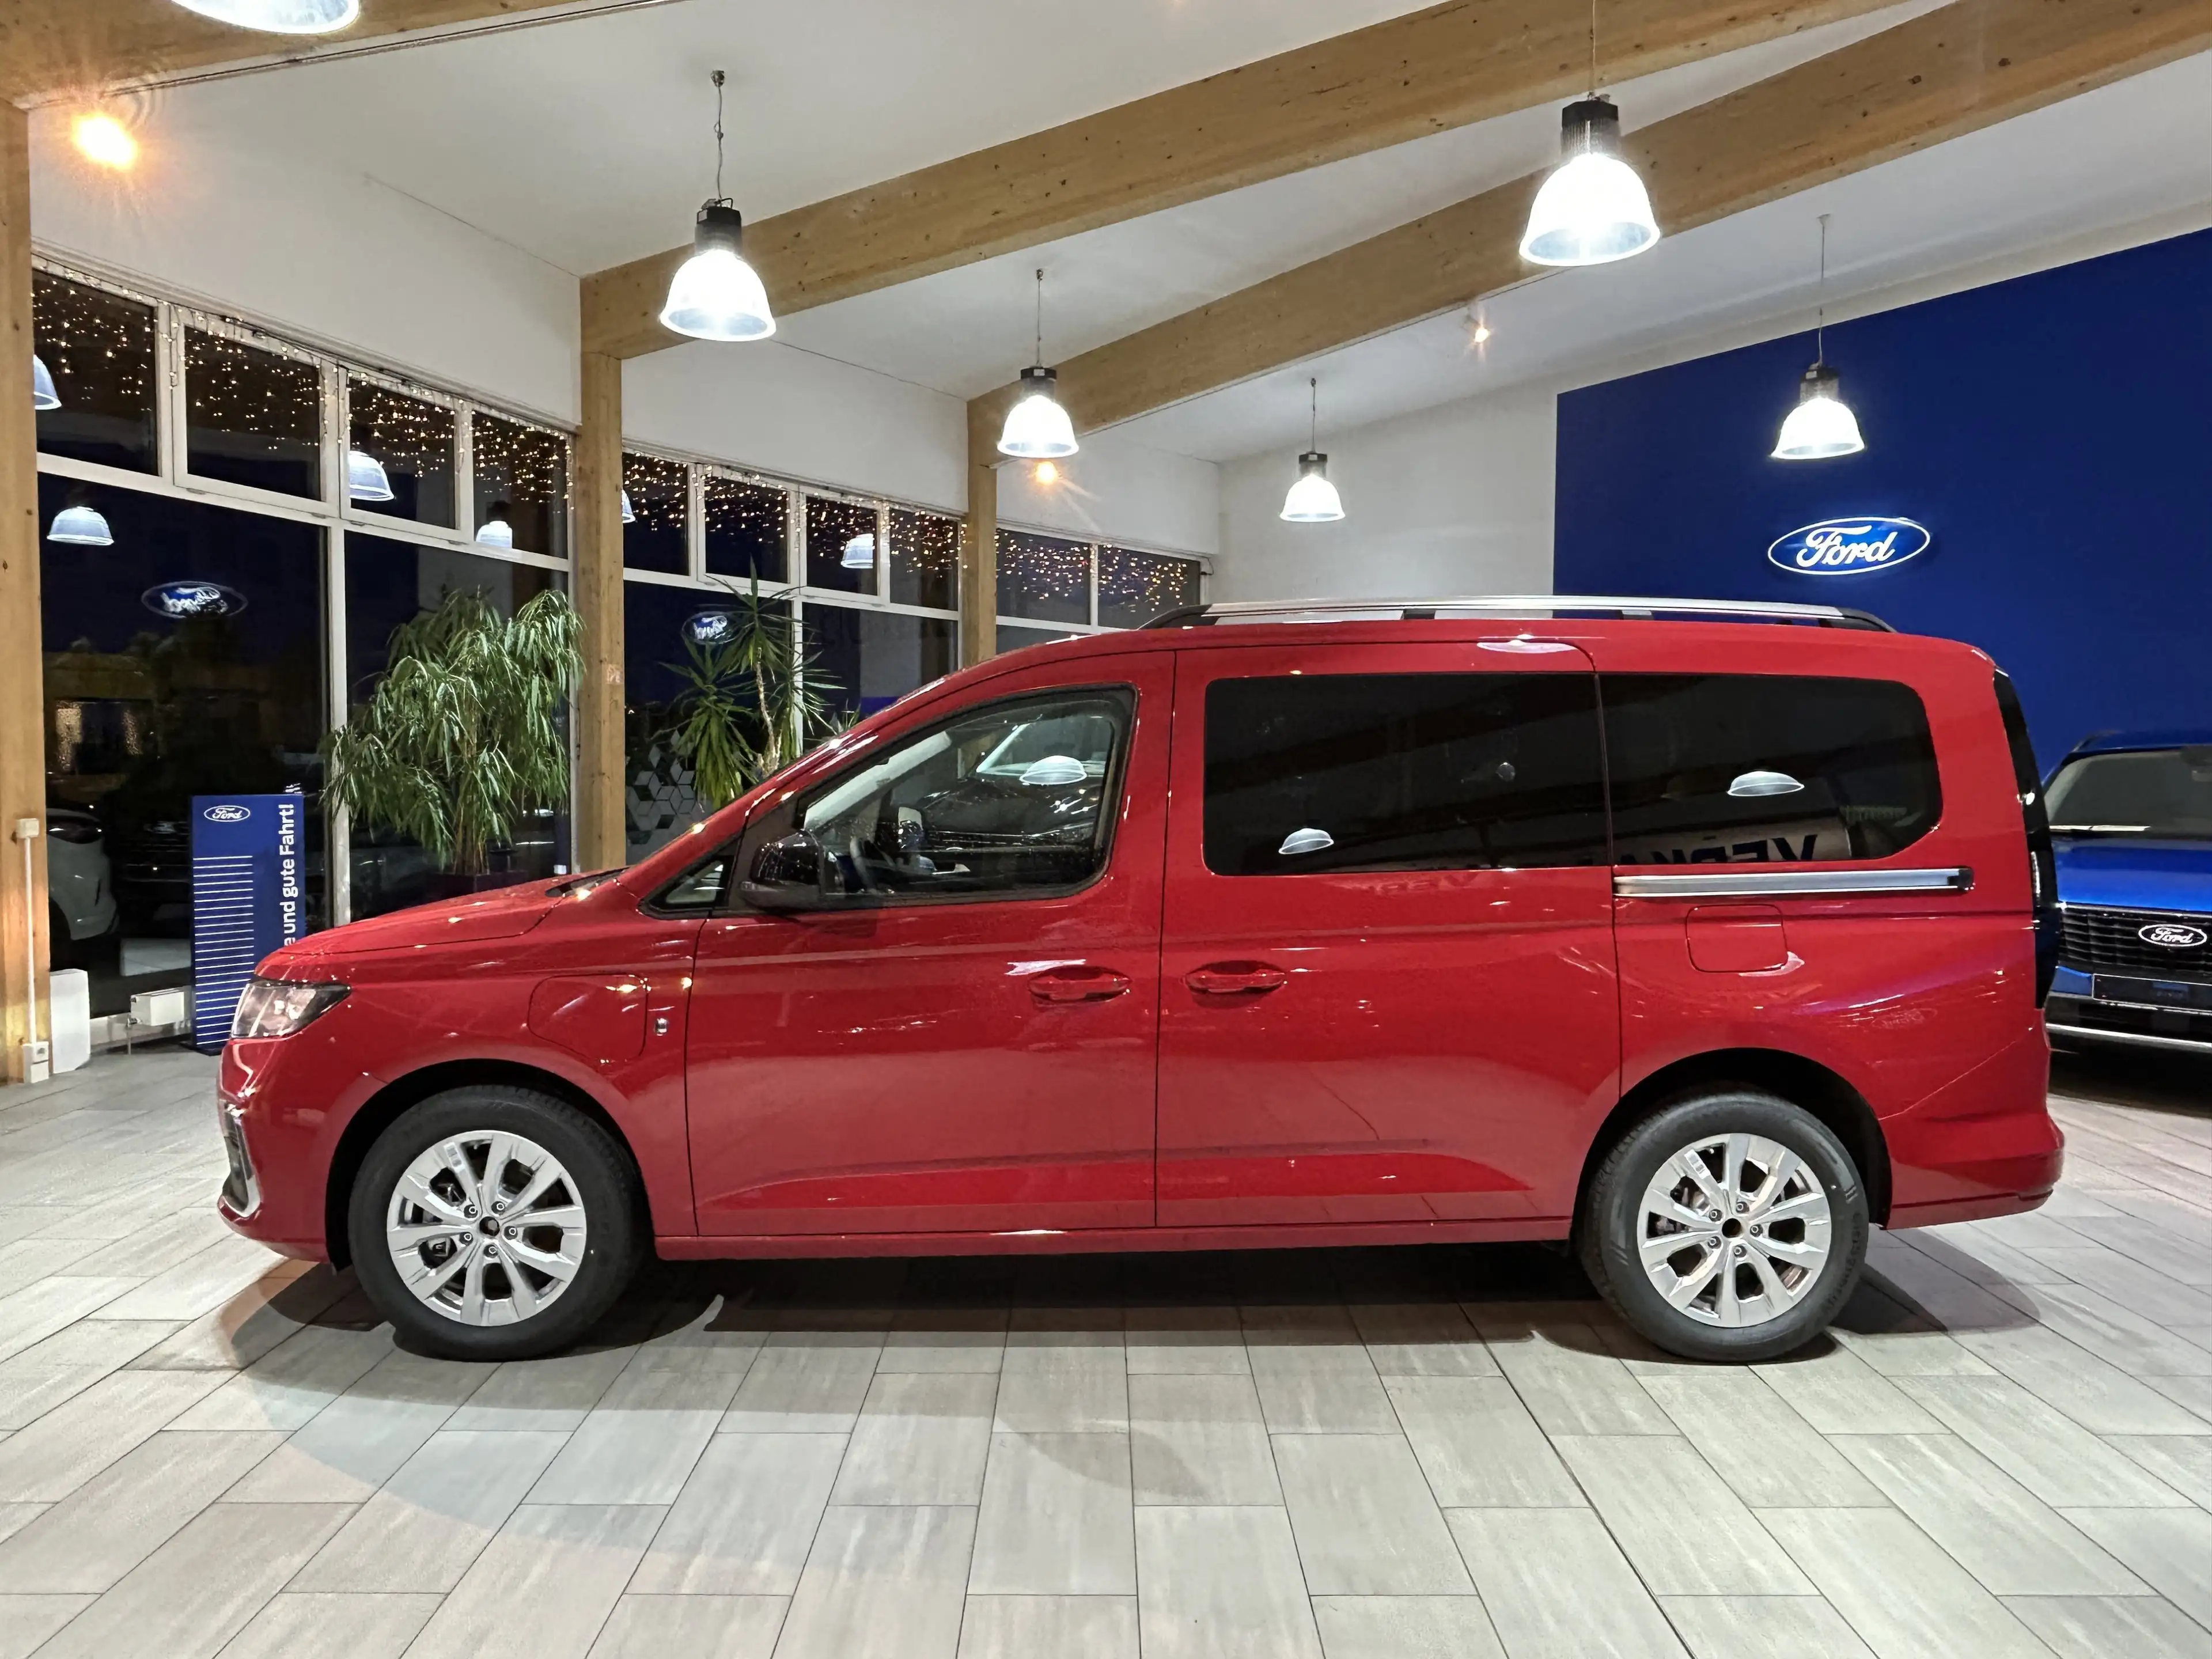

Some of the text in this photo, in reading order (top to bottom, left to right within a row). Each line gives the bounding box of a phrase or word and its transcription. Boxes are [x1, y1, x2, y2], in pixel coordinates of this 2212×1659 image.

[1796, 525, 1899, 567] Ford
[212, 808, 242, 820] Ford
[278, 804, 294, 855] Fahrt!
[279, 859, 298, 897] gute
[280, 900, 296, 933] und
[2150, 927, 2193, 944] Ford
